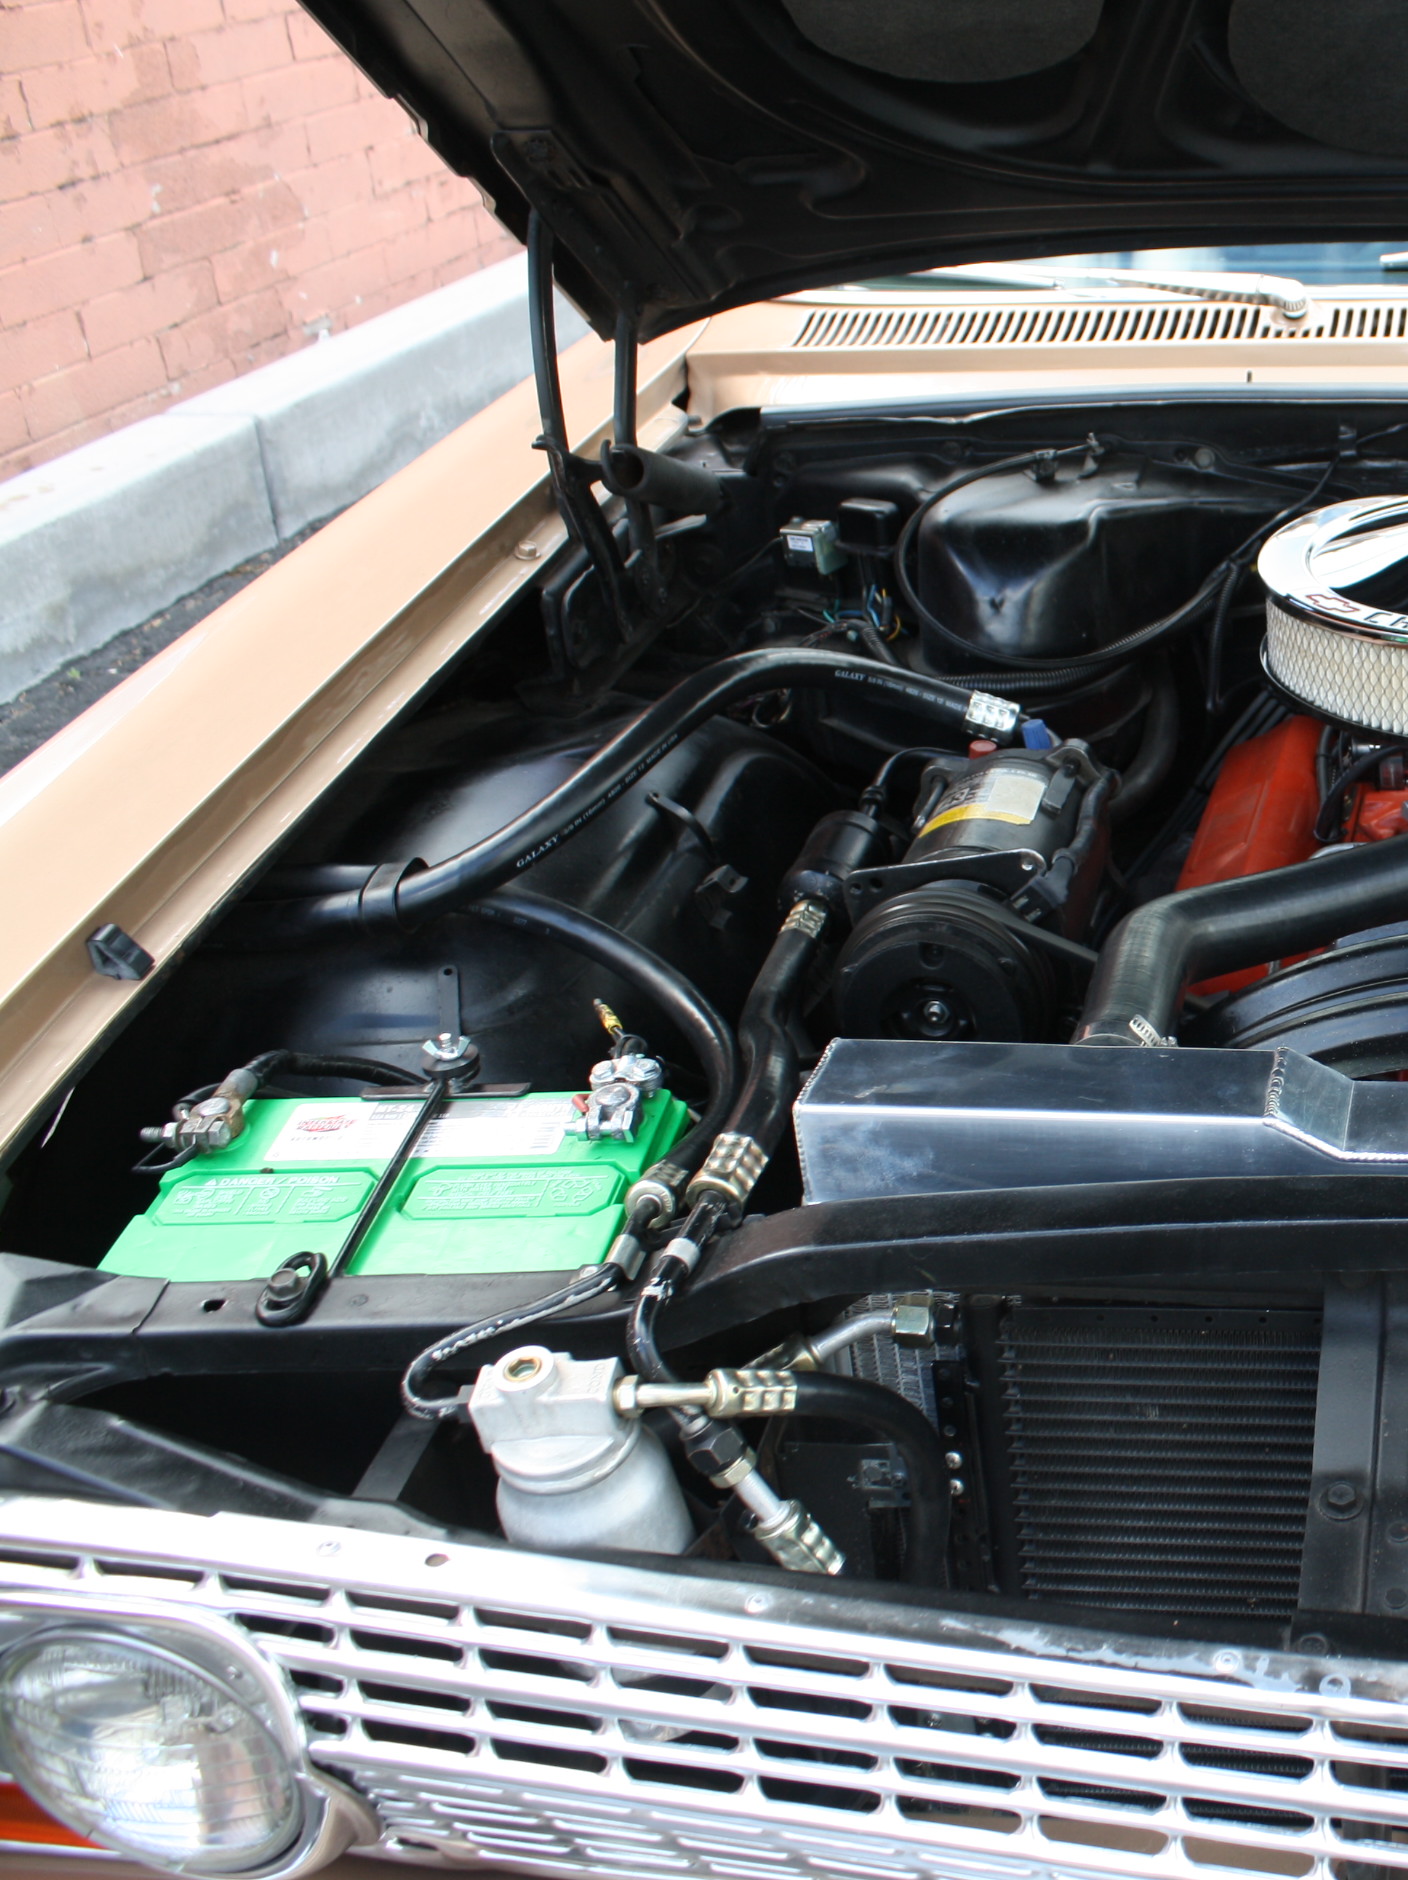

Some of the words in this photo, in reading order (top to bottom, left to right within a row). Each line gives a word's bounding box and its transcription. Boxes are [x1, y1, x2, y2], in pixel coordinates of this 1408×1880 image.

[834, 669, 867, 681] GALAXY
[516, 834, 559, 868] GALAXY
[220, 1177, 275, 1187] DANGER
[287, 1175, 340, 1185] POISON
